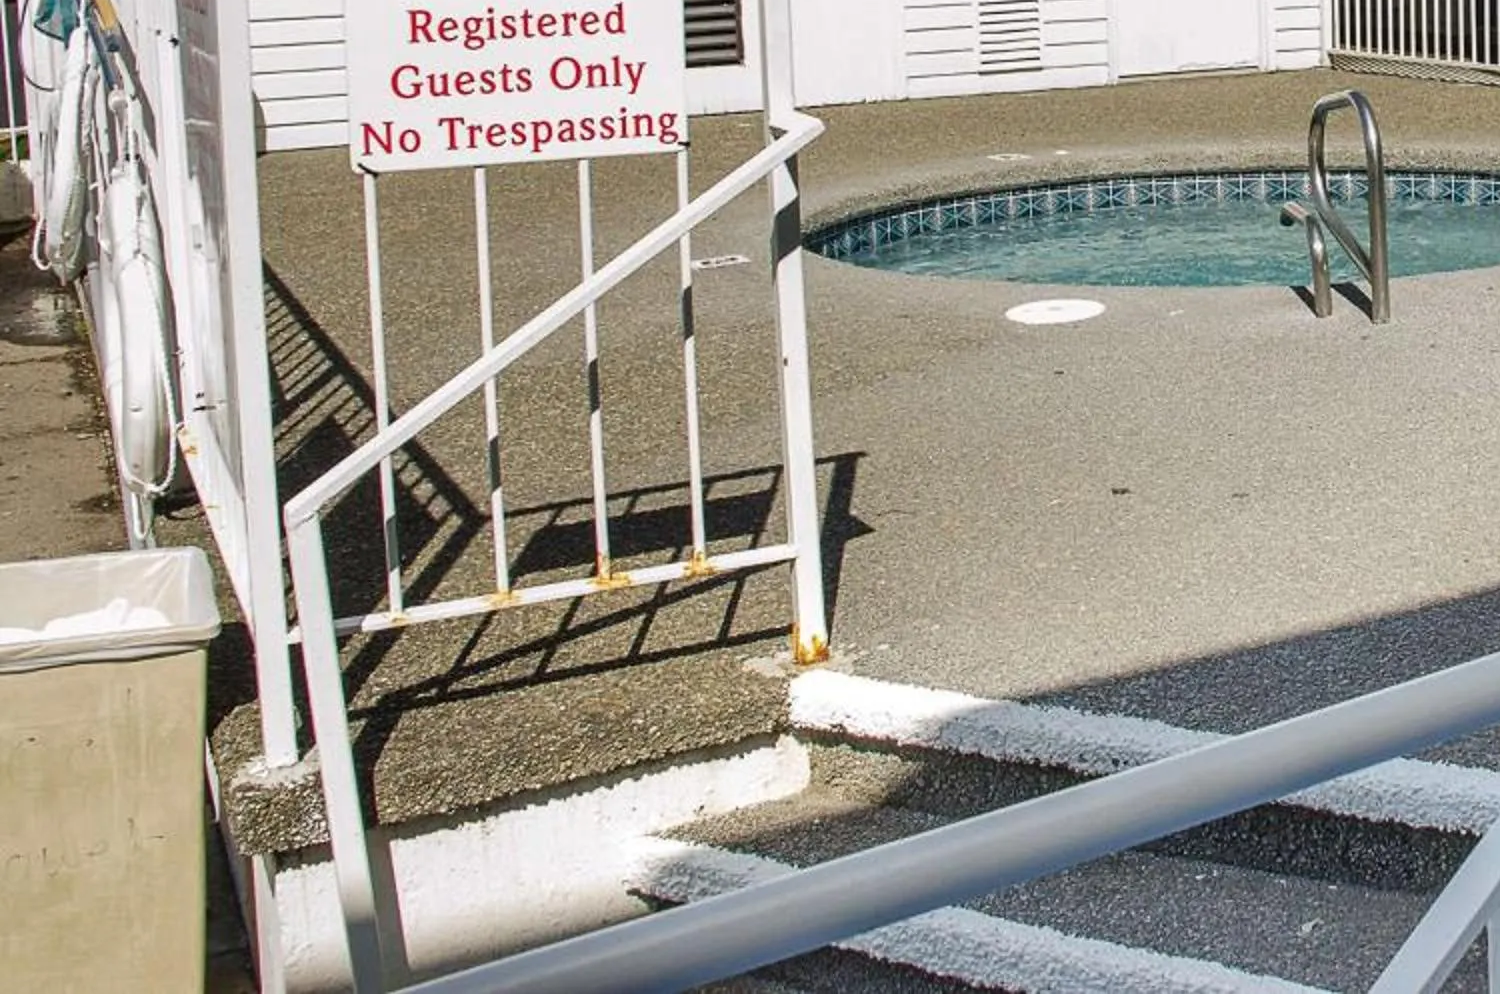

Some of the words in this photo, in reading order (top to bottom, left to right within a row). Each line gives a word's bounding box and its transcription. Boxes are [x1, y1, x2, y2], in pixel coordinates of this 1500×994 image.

[406, 1, 627, 50] Registered
[390, 63, 533, 99] Guests
[549, 55, 646, 94] Only
[361, 120, 421, 156] No
[438, 107, 679, 153] Trespassing
